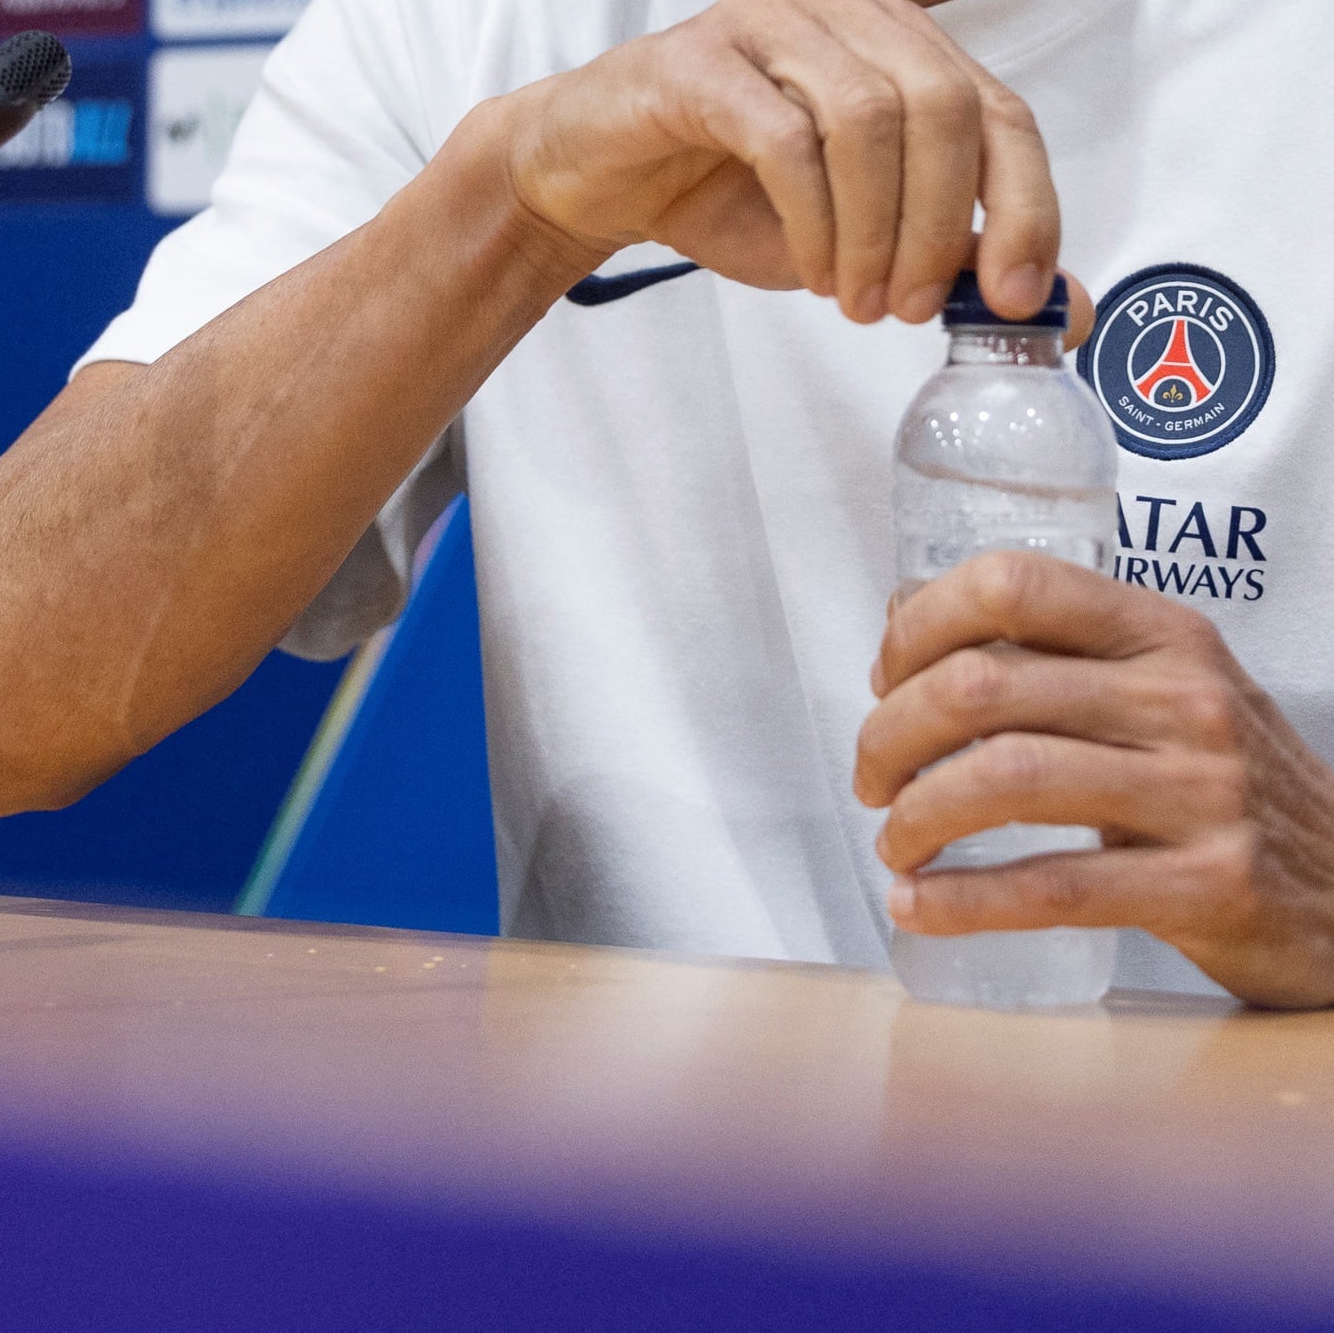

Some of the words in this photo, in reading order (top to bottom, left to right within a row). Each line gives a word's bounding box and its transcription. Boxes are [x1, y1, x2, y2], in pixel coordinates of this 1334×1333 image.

[1126, 290, 1234, 332] PARIS
[1118, 395, 1157, 426] SAINT
[1164, 401, 1225, 432] GERMAIN
